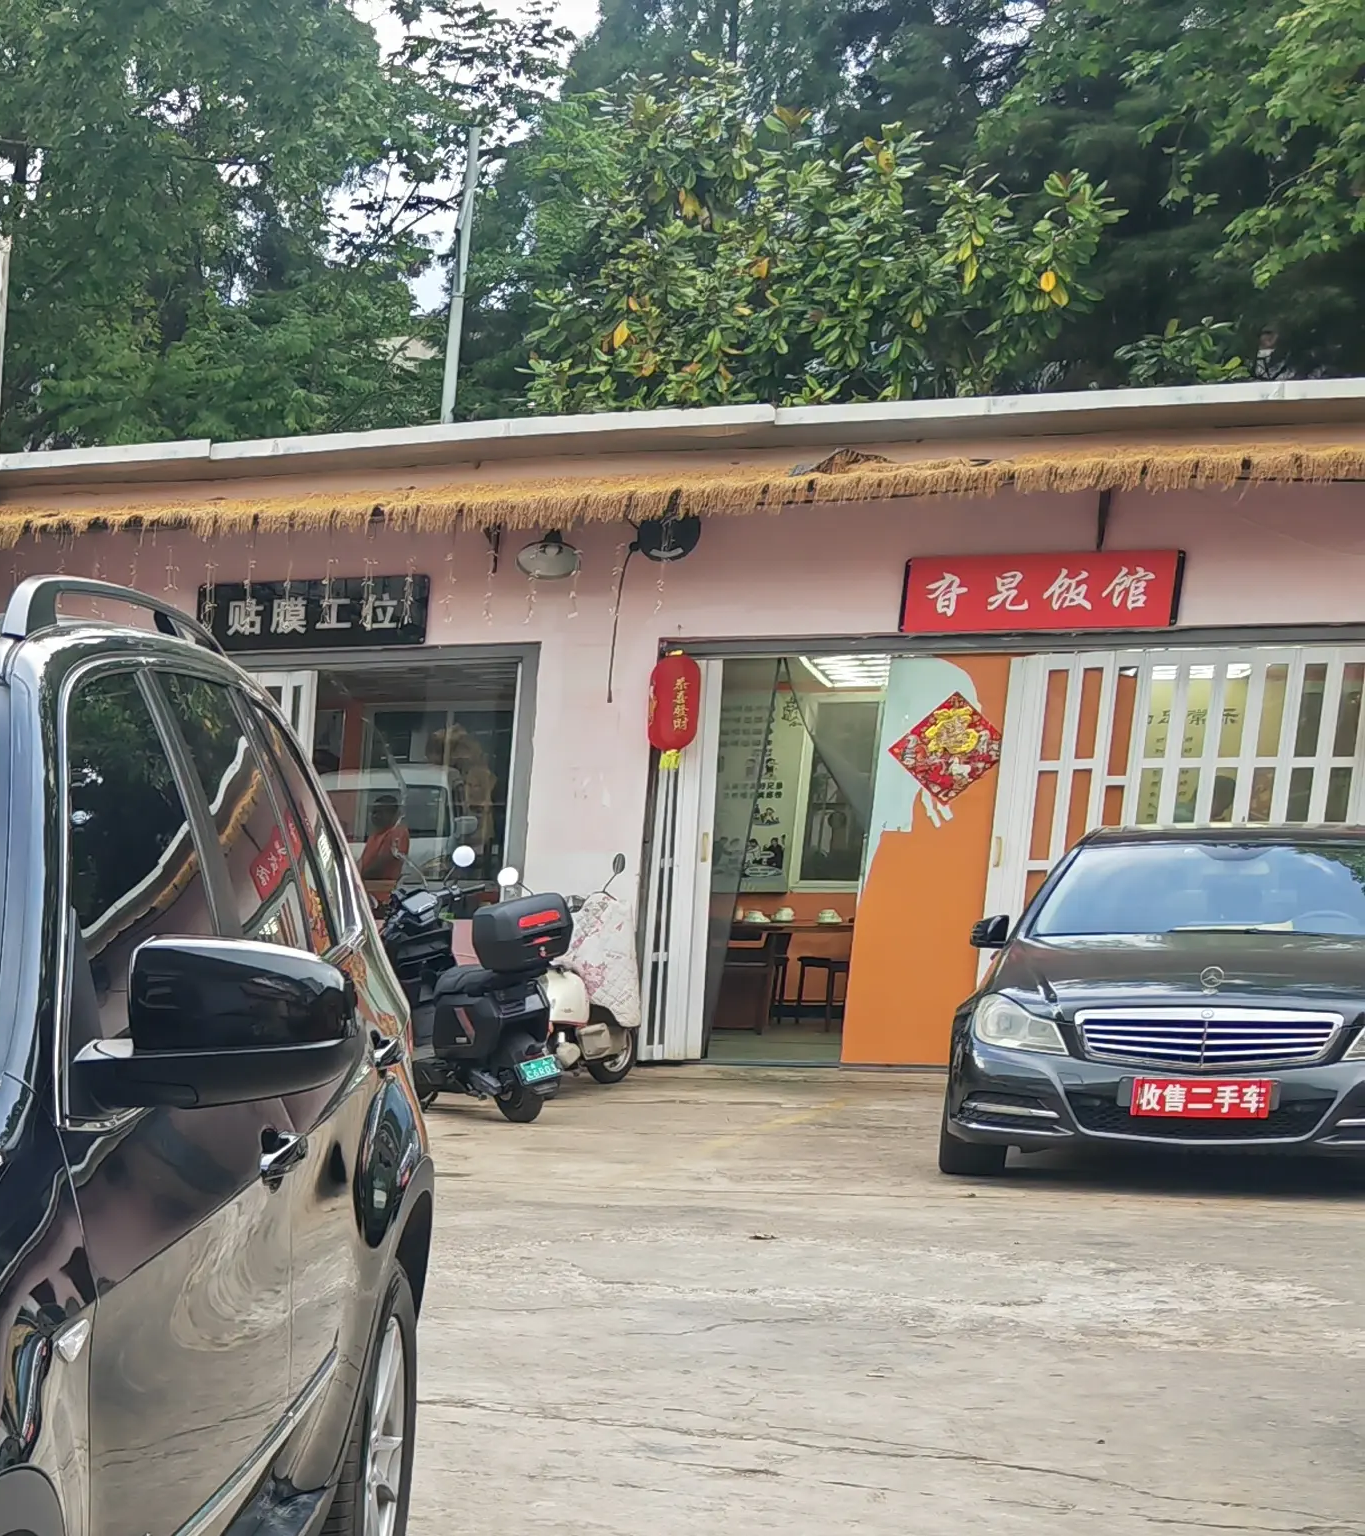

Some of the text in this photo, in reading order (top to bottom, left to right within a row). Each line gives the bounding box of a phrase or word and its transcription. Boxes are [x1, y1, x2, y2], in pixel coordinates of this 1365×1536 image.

[925, 565, 1156, 617] 旮旯饭馆
[226, 593, 398, 636] 贴膜工位
[1137, 1084, 1267, 1115] 收售二手车
